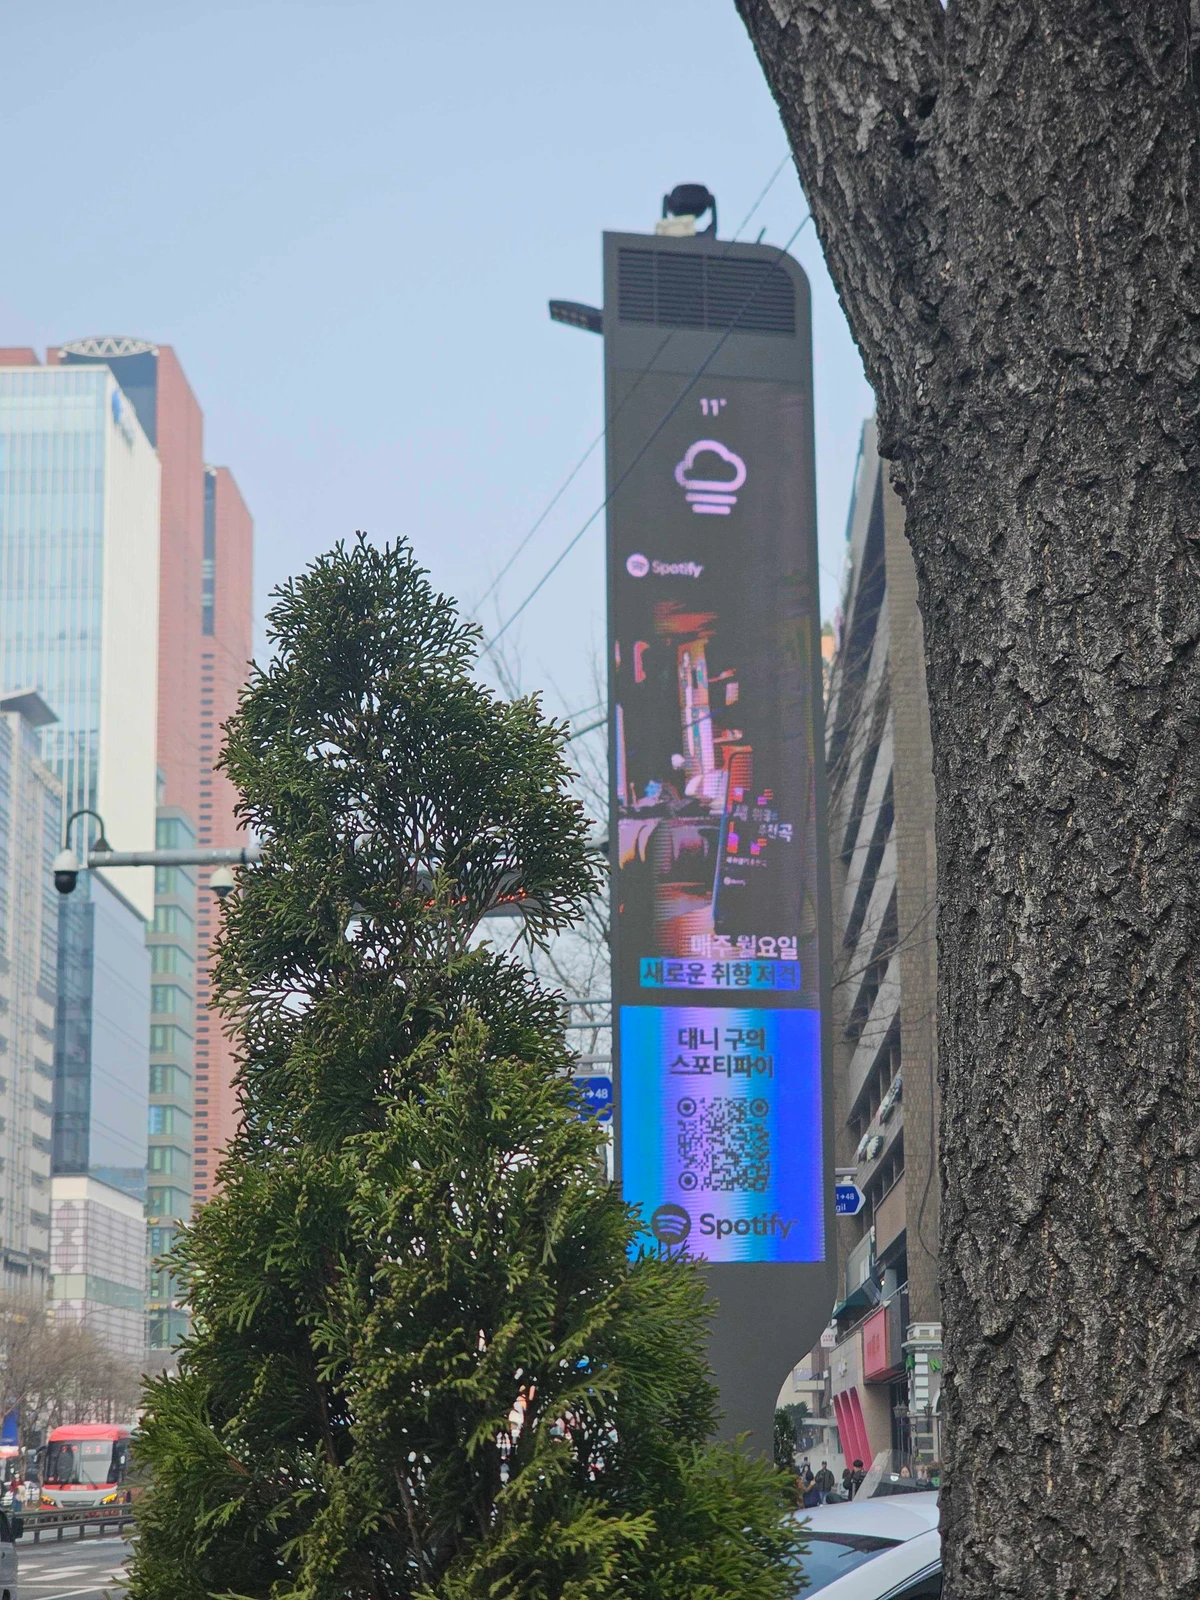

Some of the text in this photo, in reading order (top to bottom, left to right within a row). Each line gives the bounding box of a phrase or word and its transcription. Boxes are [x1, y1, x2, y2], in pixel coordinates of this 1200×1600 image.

[652, 560, 703, 578] Spotify
[690, 933, 798, 960] 매주 월요일
[644, 962, 796, 986] 새로운 취향 저격
[678, 1027, 765, 1051] 대니 구의
[670, 1054, 773, 1078] 스포티파이
[595, 1088, 609, 1099] 48
[699, 1212, 793, 1239] Spotify
